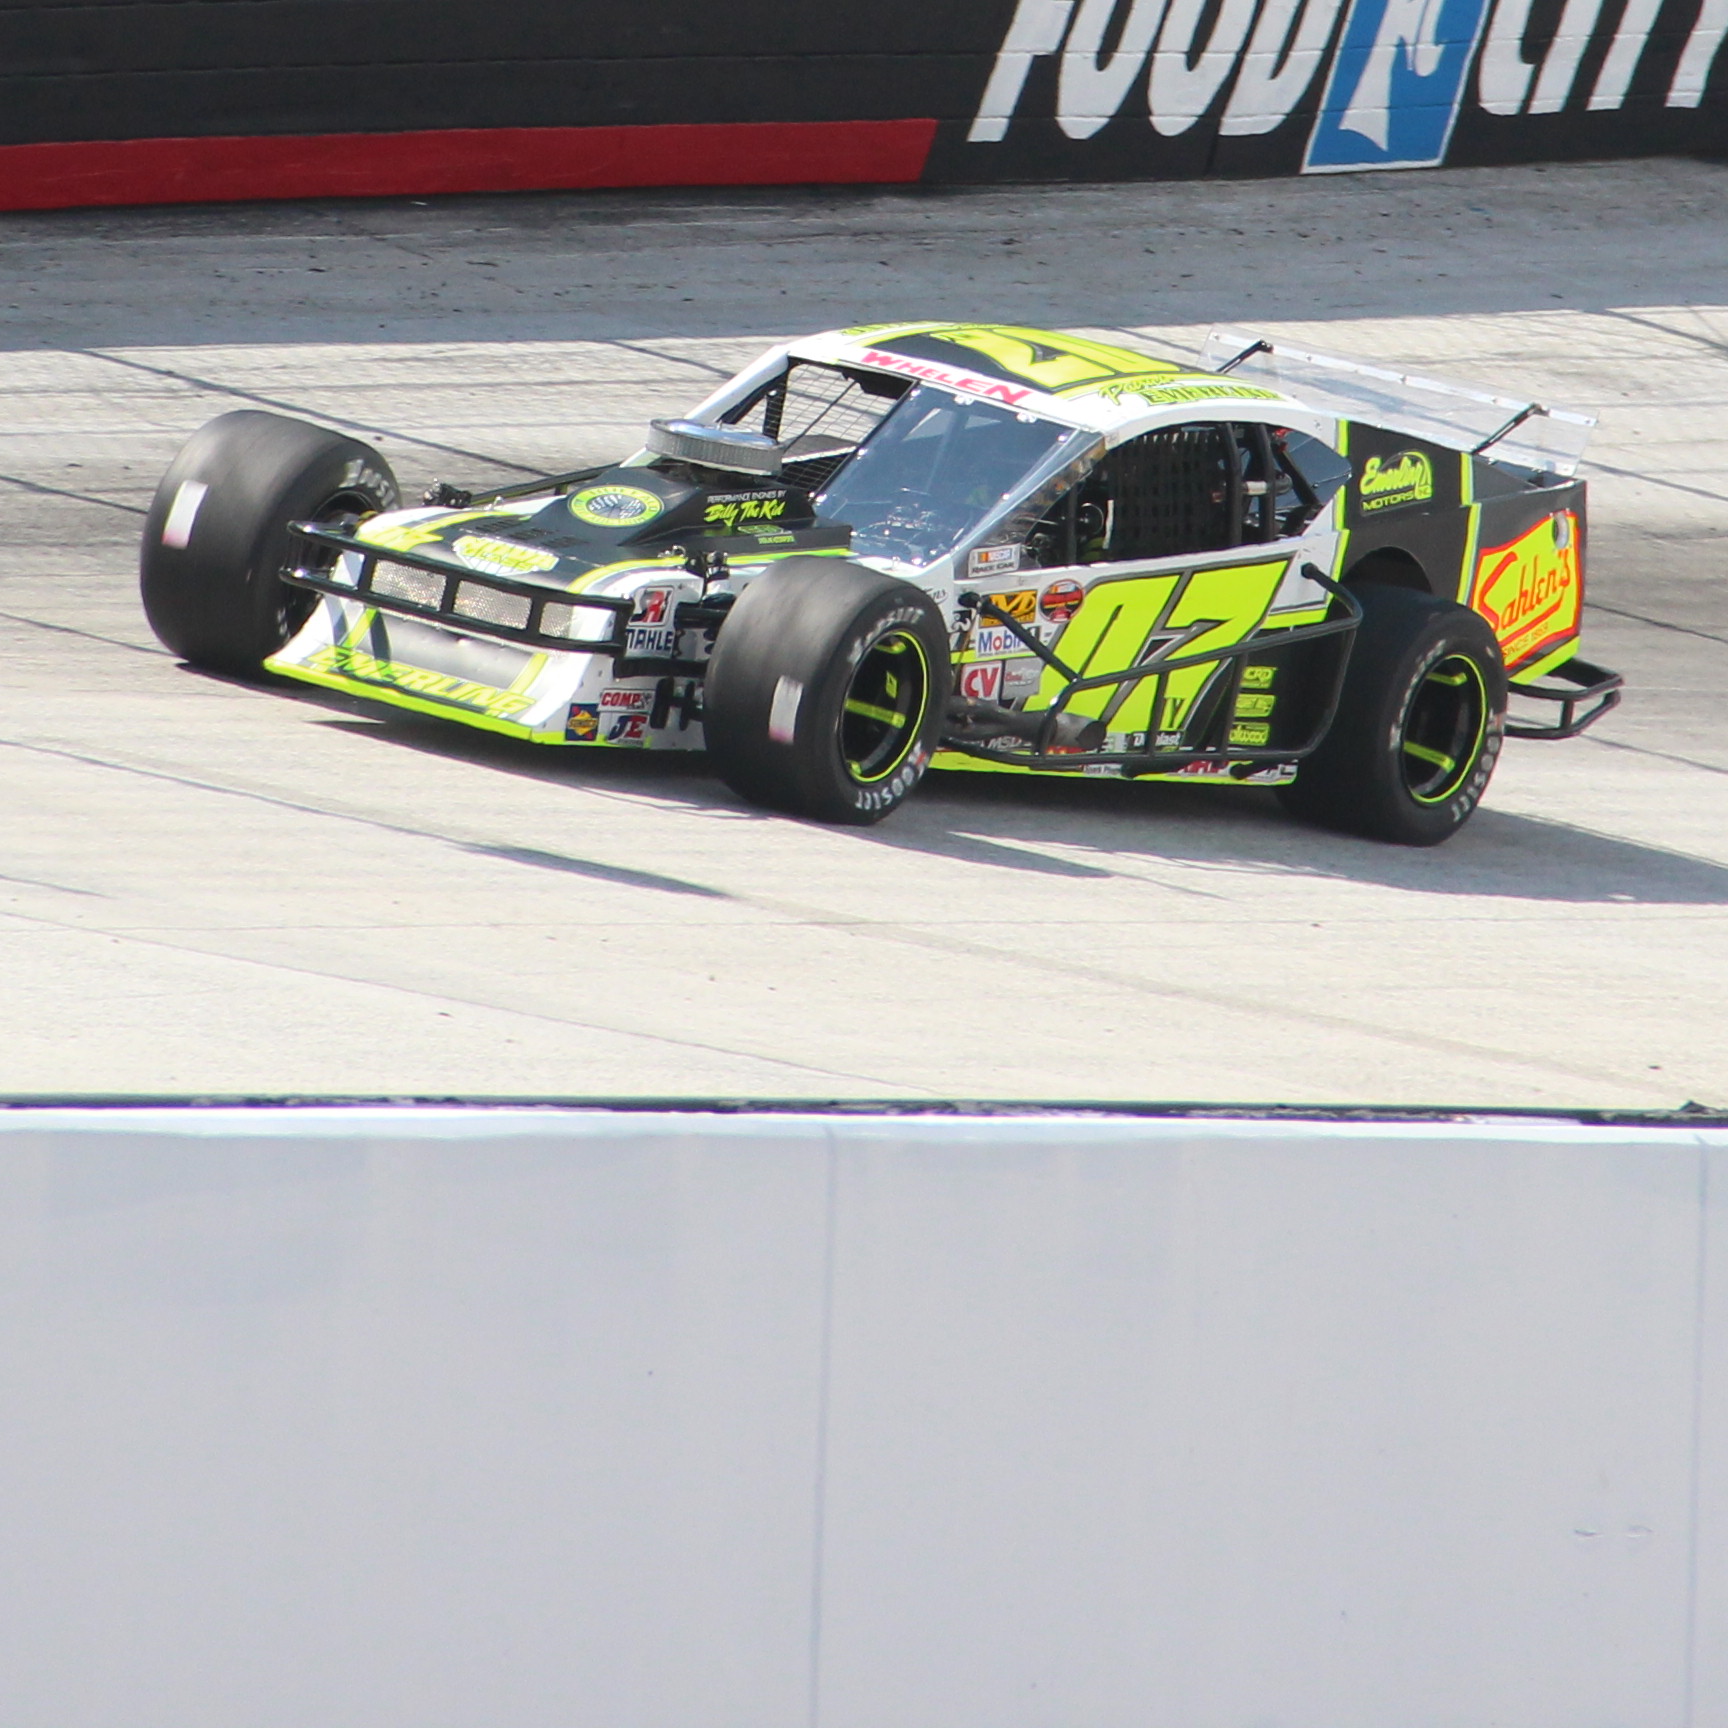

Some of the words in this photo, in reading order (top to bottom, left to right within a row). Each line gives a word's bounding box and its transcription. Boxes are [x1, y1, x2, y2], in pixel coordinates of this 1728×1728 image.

[860, 351, 1034, 405] WHELEN
[703, 503, 740, 526] Billy
[759, 499, 787, 520] Kid
[1362, 491, 1414, 512] MOTORS
[1477, 549, 1571, 633] Sahlen's
[626, 629, 673, 651] MAHLE
[306, 645, 536, 718] EMERLING
[601, 692, 643, 707] COMP
[607, 714, 648, 740] JE
